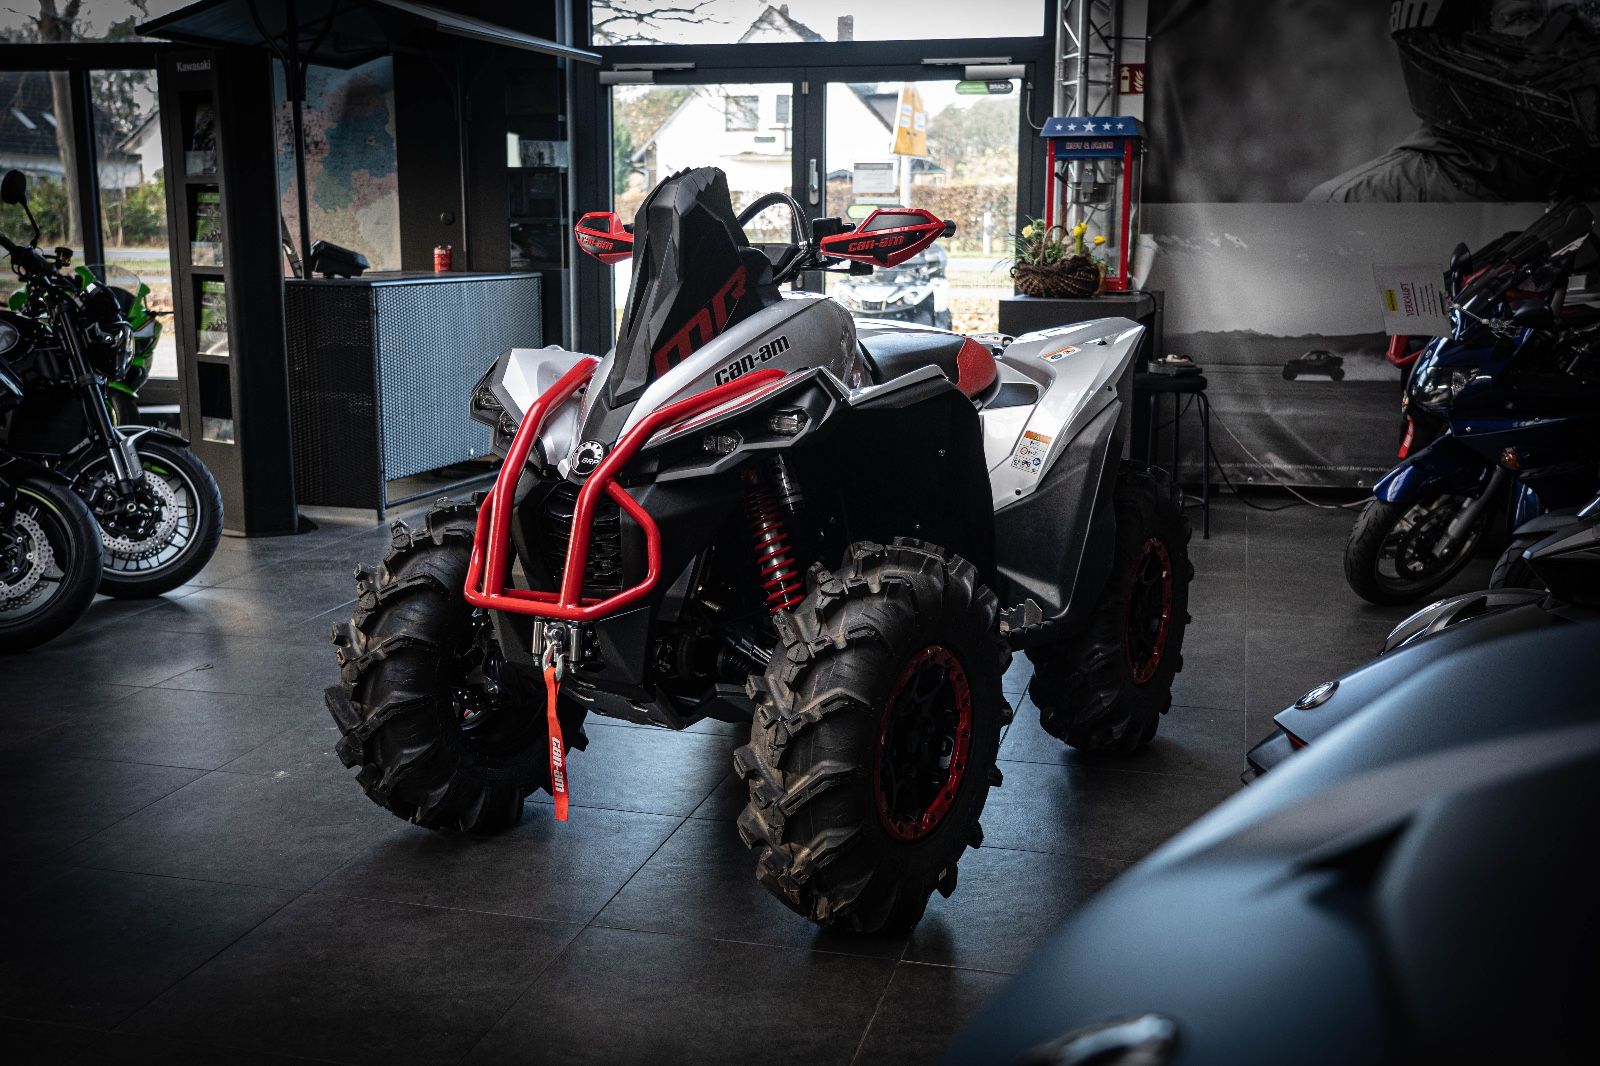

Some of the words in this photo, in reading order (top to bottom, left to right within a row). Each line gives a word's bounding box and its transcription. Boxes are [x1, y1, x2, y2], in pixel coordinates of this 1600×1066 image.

[176, 59, 211, 72] Kawasaki
[848, 235, 905, 253] can-am
[714, 335, 790, 387] can-am
[581, 457, 599, 465] BRP
[551, 736, 565, 793] can-am
